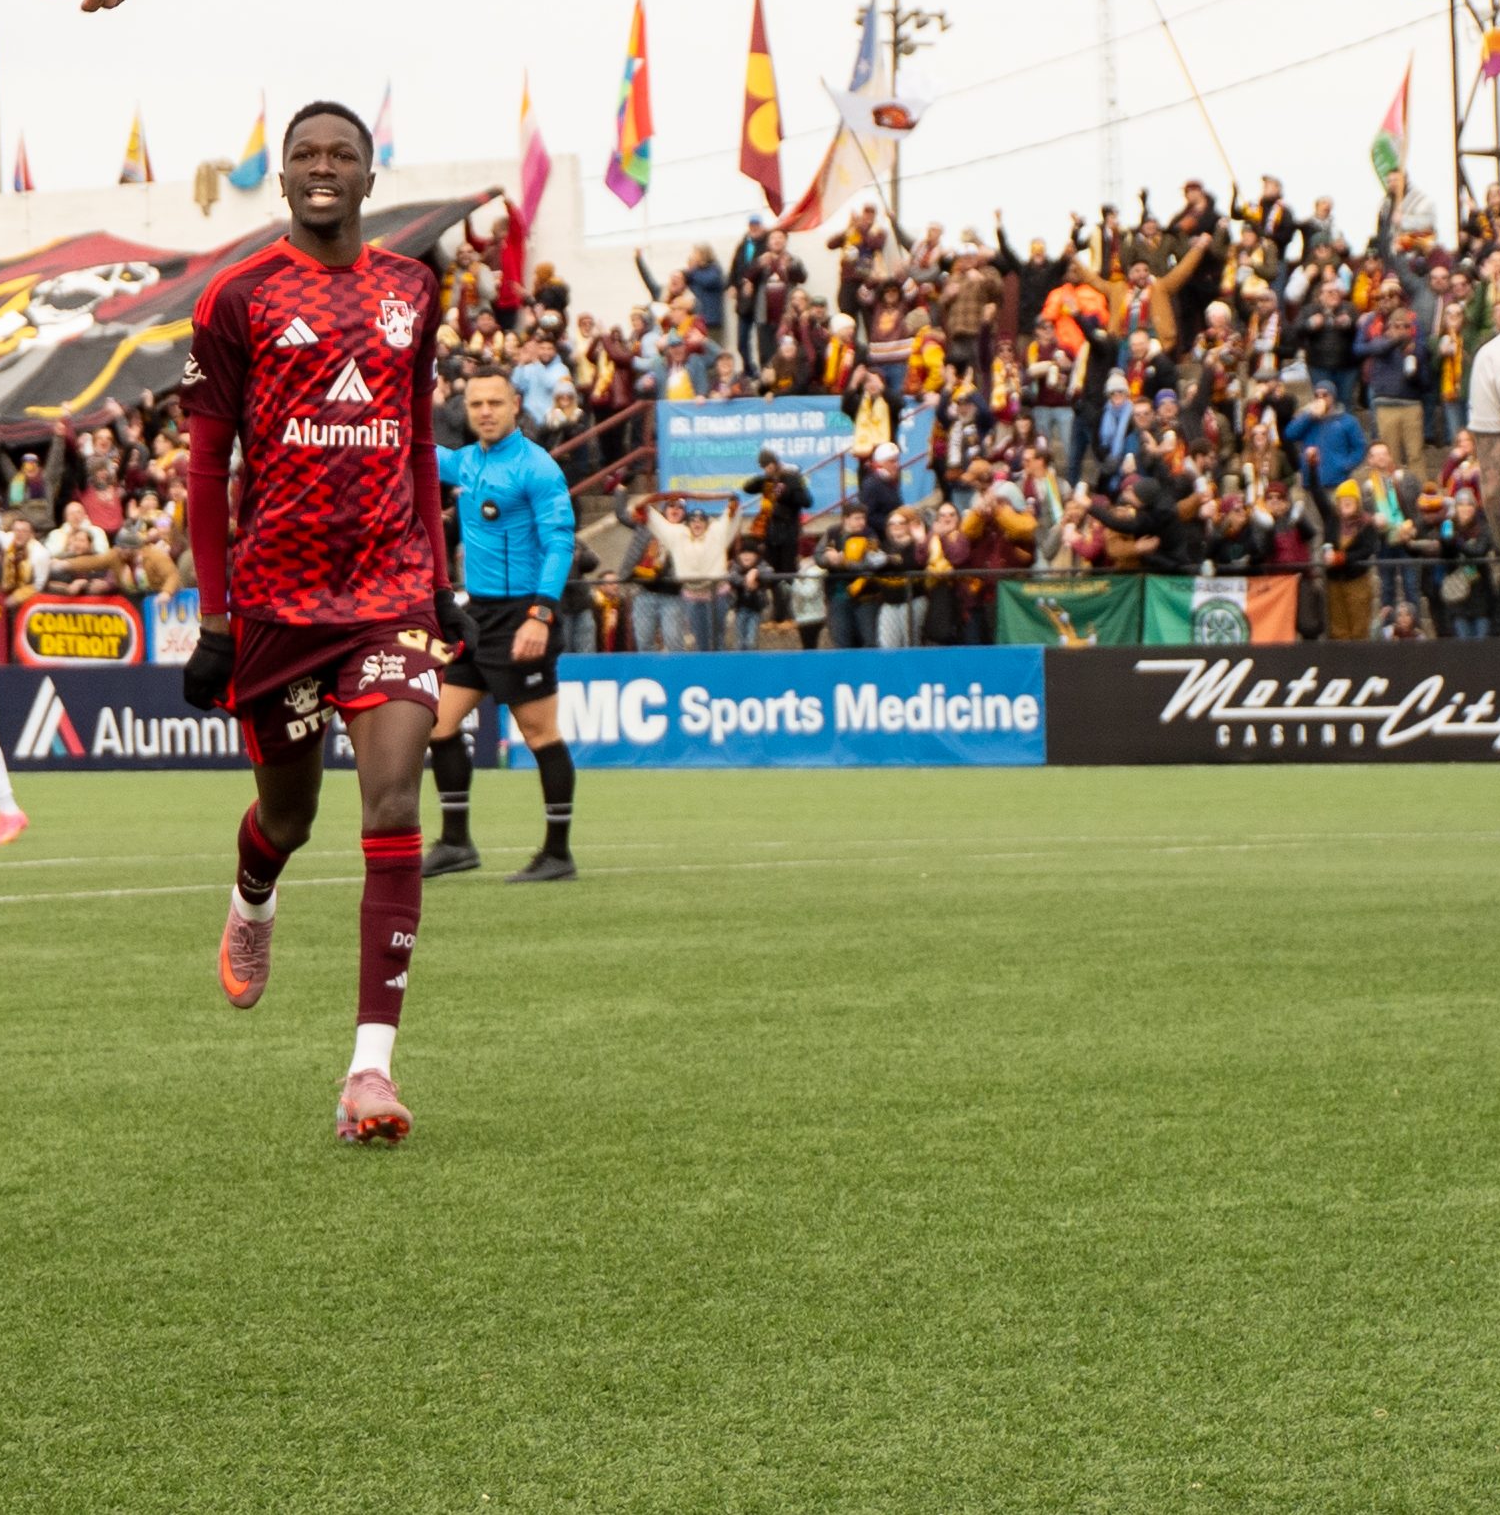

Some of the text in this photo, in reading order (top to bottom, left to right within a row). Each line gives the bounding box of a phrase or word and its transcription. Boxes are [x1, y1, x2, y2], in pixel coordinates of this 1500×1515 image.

[282, 416, 401, 447] AlumniFi
[764, 412, 799, 431] TRACK
[801, 411, 826, 430] FOR
[787, 436, 812, 455] LEFT
[28, 611, 129, 636] COALITION
[39, 634, 122, 658] DETROIT
[1136, 658, 1400, 722] Motor
[508, 677, 668, 744] MC
[680, 685, 825, 743] Sports
[834, 682, 1040, 732] Medicine
[92, 706, 239, 757] Alumni
[1217, 723, 1365, 748] CASINO
